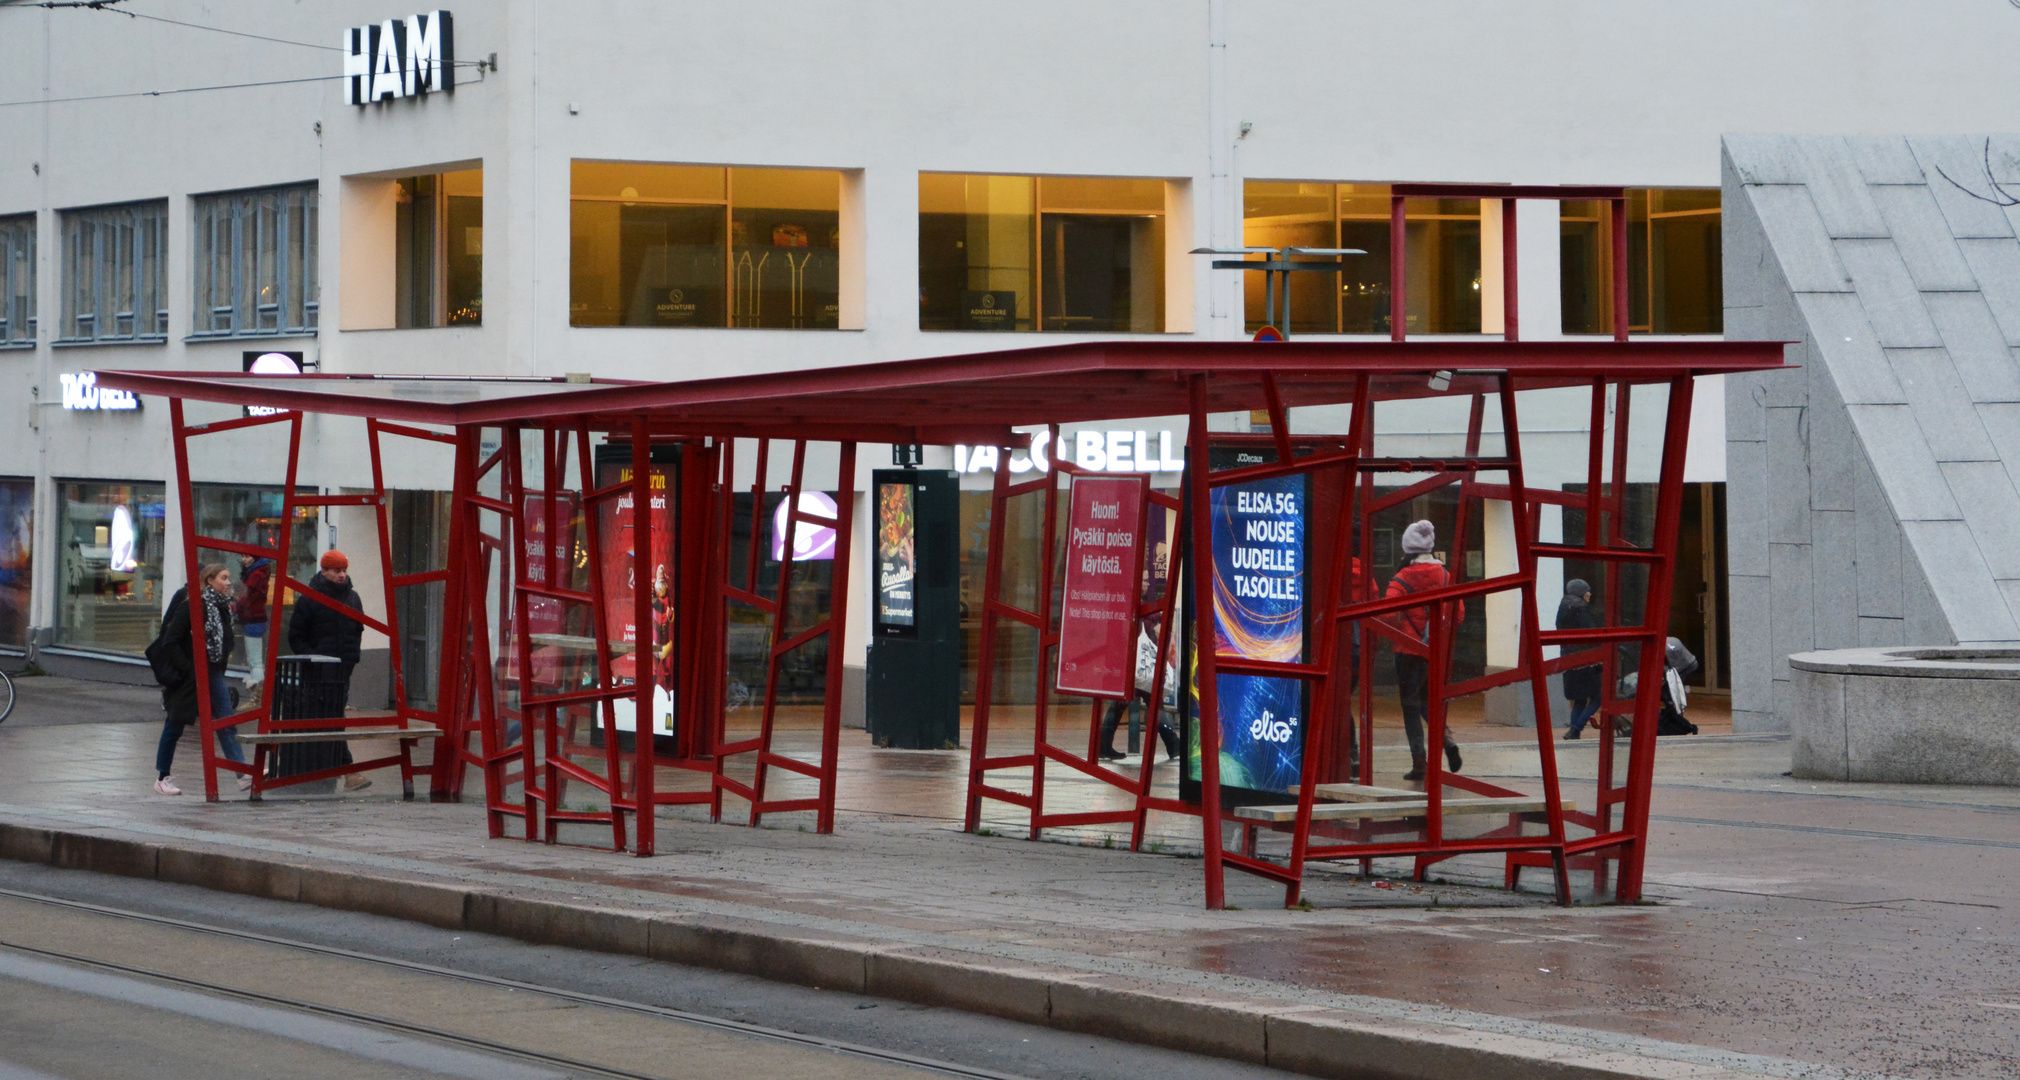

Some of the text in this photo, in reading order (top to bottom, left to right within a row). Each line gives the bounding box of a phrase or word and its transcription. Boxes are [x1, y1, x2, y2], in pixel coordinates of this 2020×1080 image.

[343, 10, 447, 106] HAM
[248, 405, 276, 417] TACO
[1076, 430, 1185, 472] BELL
[1237, 453, 1263, 464] JCDecaux
[1091, 501, 1120, 519] Huom!
[1238, 492, 1298, 515] ELISA 5G.
[1073, 527, 1133, 550] Pysäkki poissa
[1246, 520, 1295, 543] NOUSE
[1082, 554, 1122, 576] käytöstä.
[1153, 562, 1167, 570] TAC
[1232, 547, 1295, 572] UUDELLE
[1234, 575, 1299, 601] TASOLLE.
[1250, 710, 1298, 743] elisa 5G
